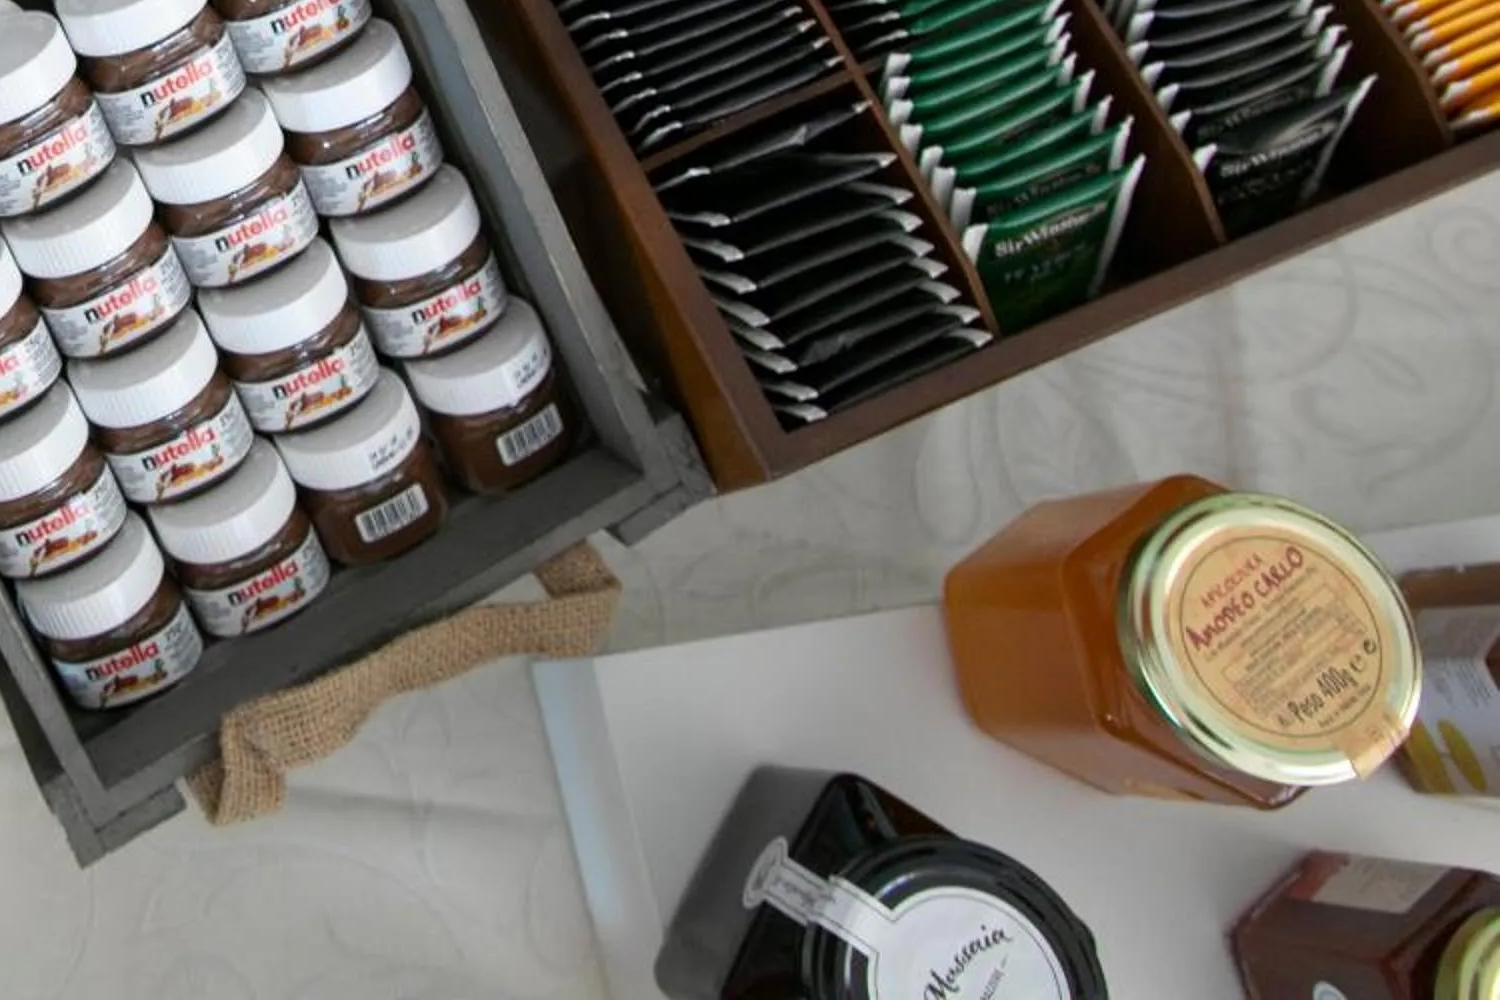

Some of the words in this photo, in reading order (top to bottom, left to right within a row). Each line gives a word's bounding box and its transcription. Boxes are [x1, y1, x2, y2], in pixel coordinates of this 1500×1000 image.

[140, 57, 213, 108] nutella
[18, 119, 90, 176] nutella
[345, 130, 417, 181] nutella
[214, 206, 290, 254] nutella
[84, 275, 158, 324] nutella
[412, 280, 483, 326] nutella
[273, 355, 346, 401] nutella
[142, 427, 218, 472] nutella
[15, 500, 91, 548] nutella
[228, 557, 301, 606] nutella
[85, 640, 160, 682] nutella
